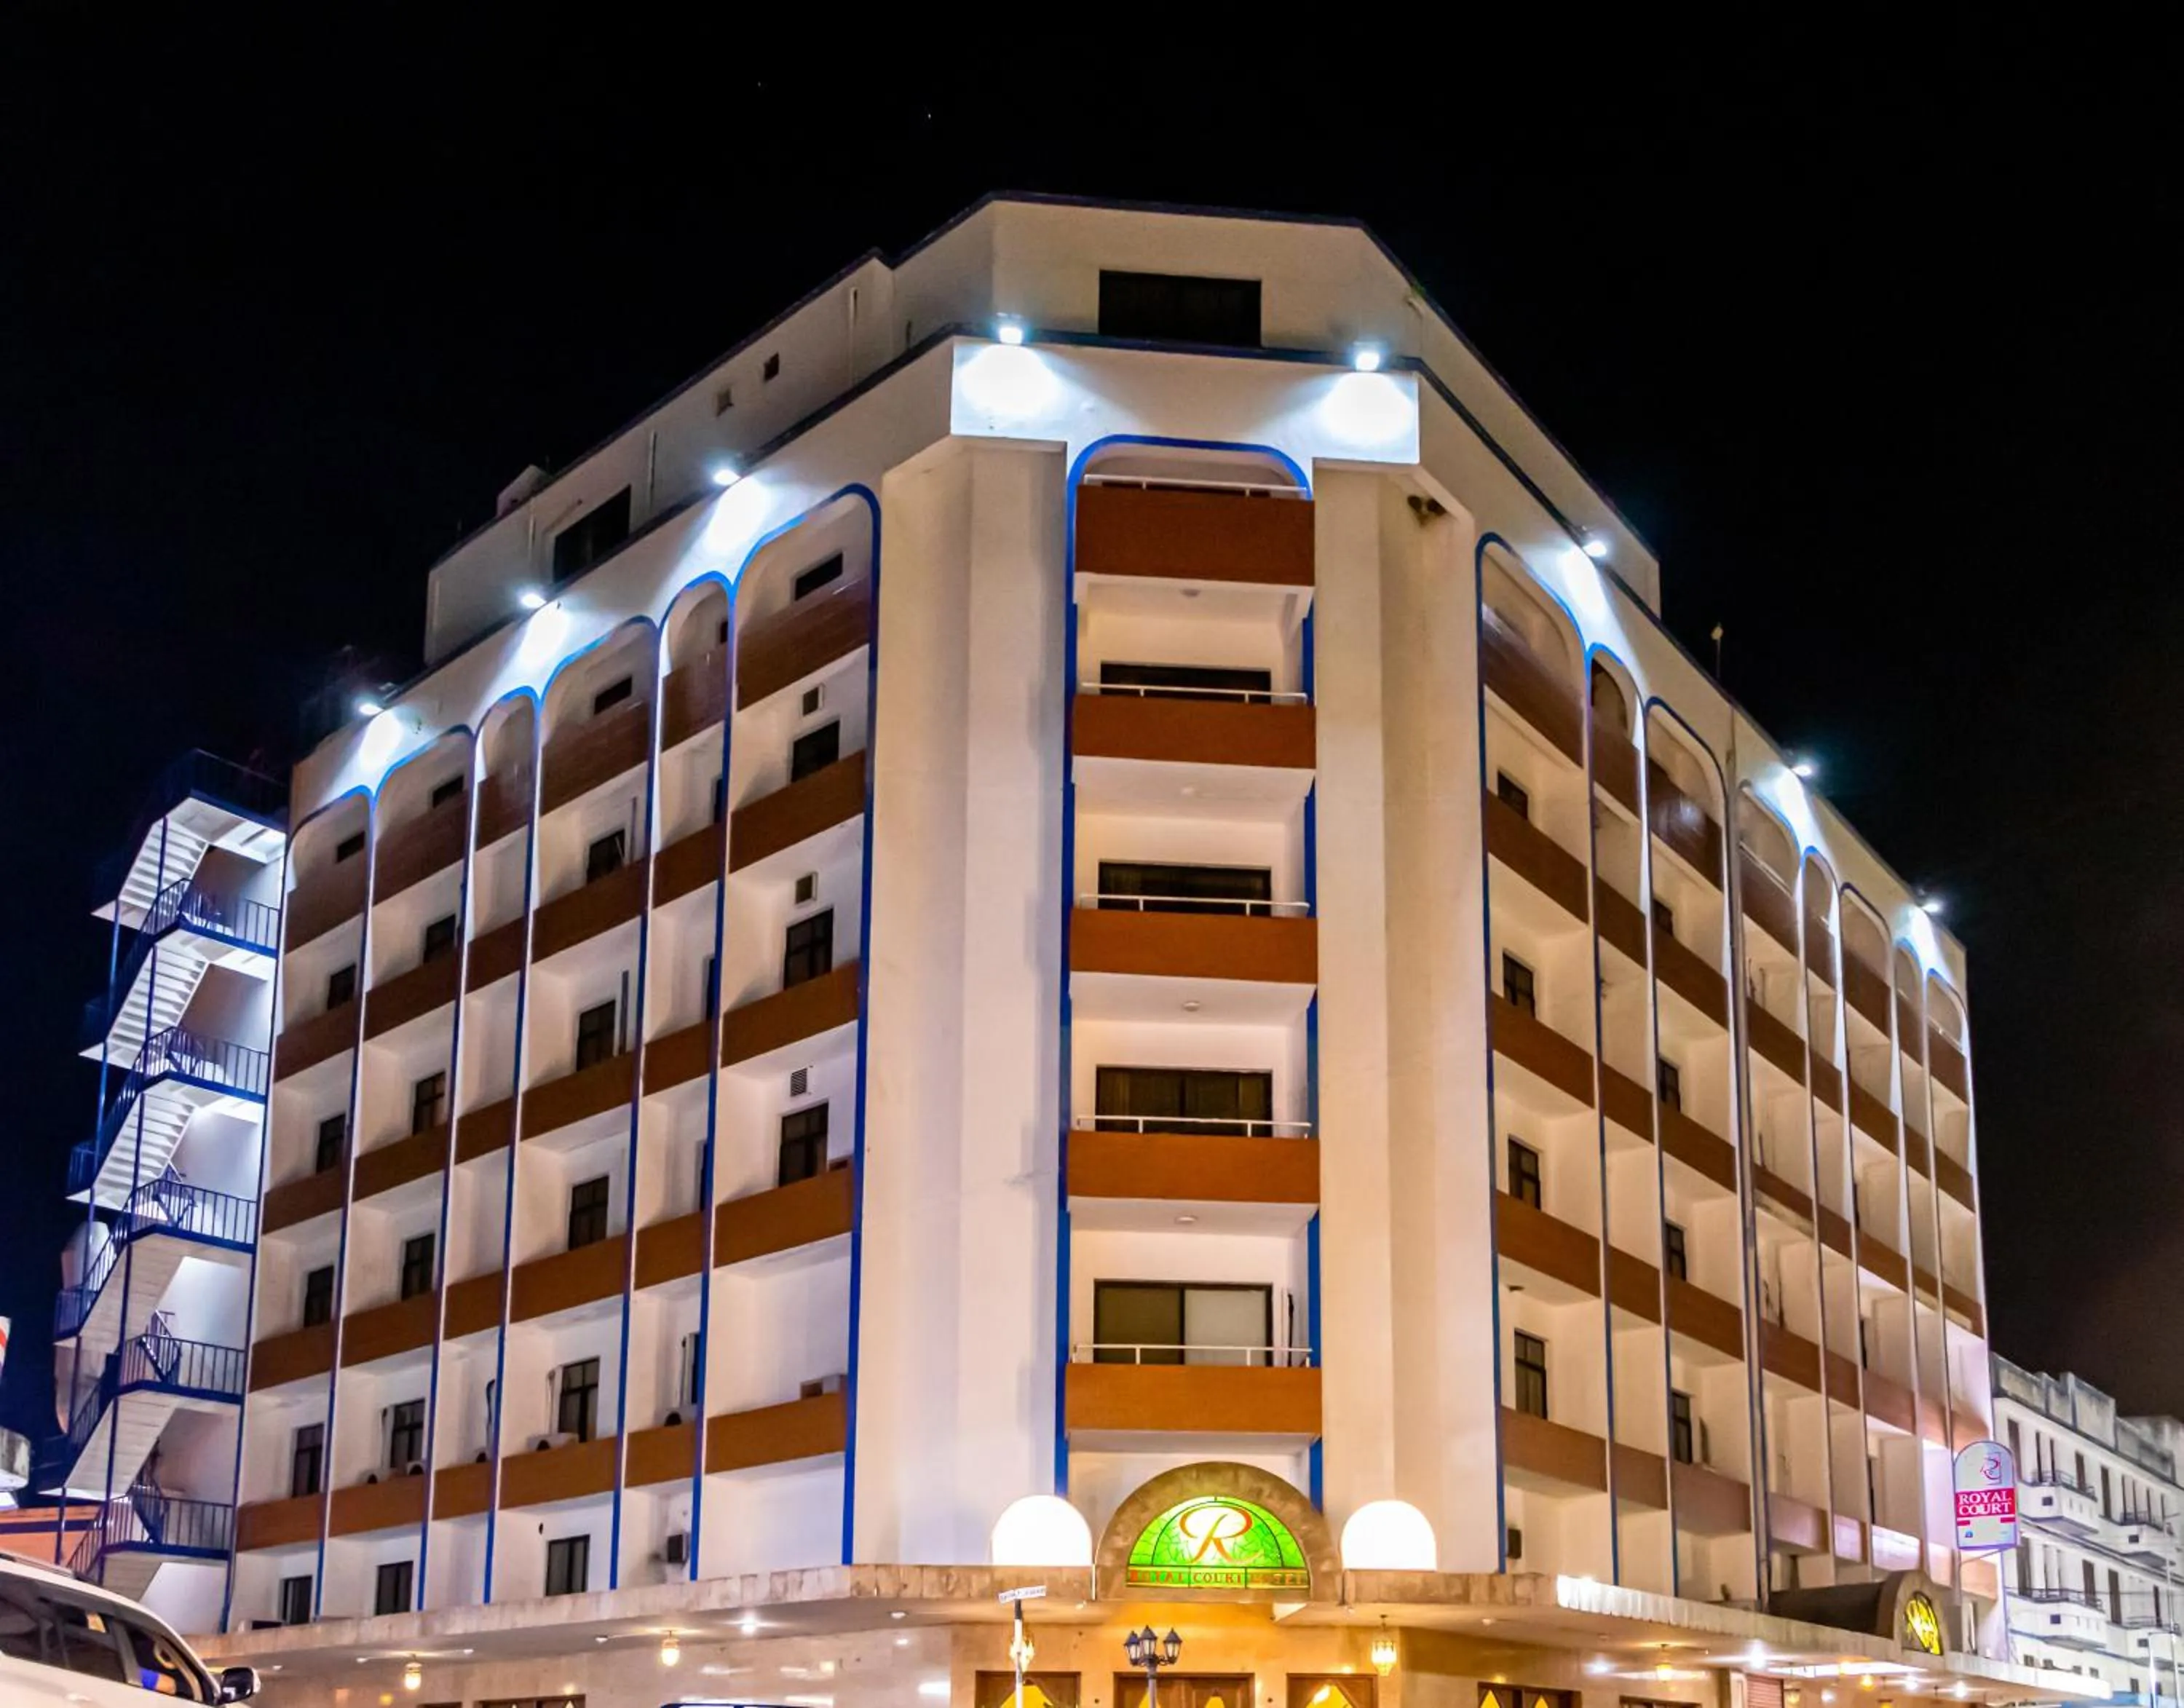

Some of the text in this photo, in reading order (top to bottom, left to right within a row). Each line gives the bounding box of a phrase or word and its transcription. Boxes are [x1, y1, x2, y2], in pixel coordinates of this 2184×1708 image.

[1959, 1491, 2012, 1504] ROYAL
[1959, 1502, 2011, 1515] COURT
[1179, 1505, 1264, 1565] R
